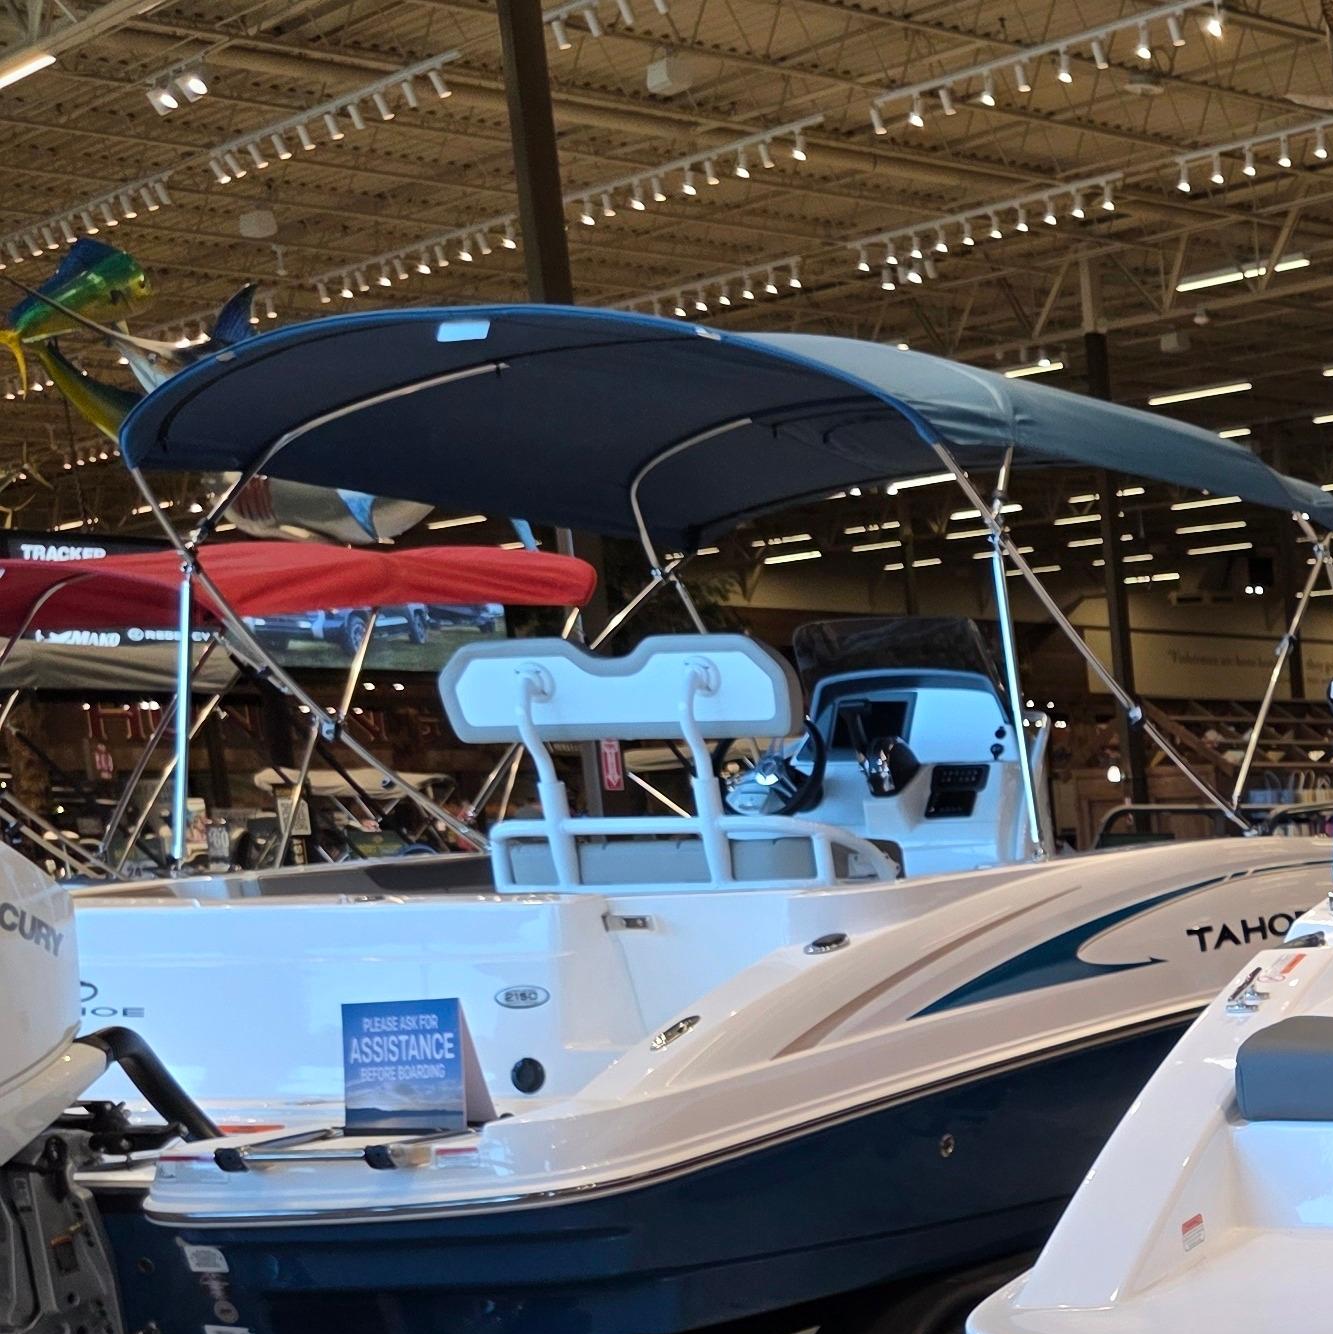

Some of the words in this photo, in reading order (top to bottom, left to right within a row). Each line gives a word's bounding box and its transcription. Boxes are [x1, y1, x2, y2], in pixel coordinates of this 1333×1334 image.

[71, 630, 121, 647] MAKO
[1186, 911, 1307, 952] TAHO
[363, 1017, 398, 1032] PLEASE
[400, 1015, 419, 1031] ASK
[419, 1014, 439, 1029] FOR
[350, 1033, 455, 1064] ASSISTANCE
[361, 1067, 397, 1082] BEFORE
[398, 1063, 446, 1081] BOARDING
